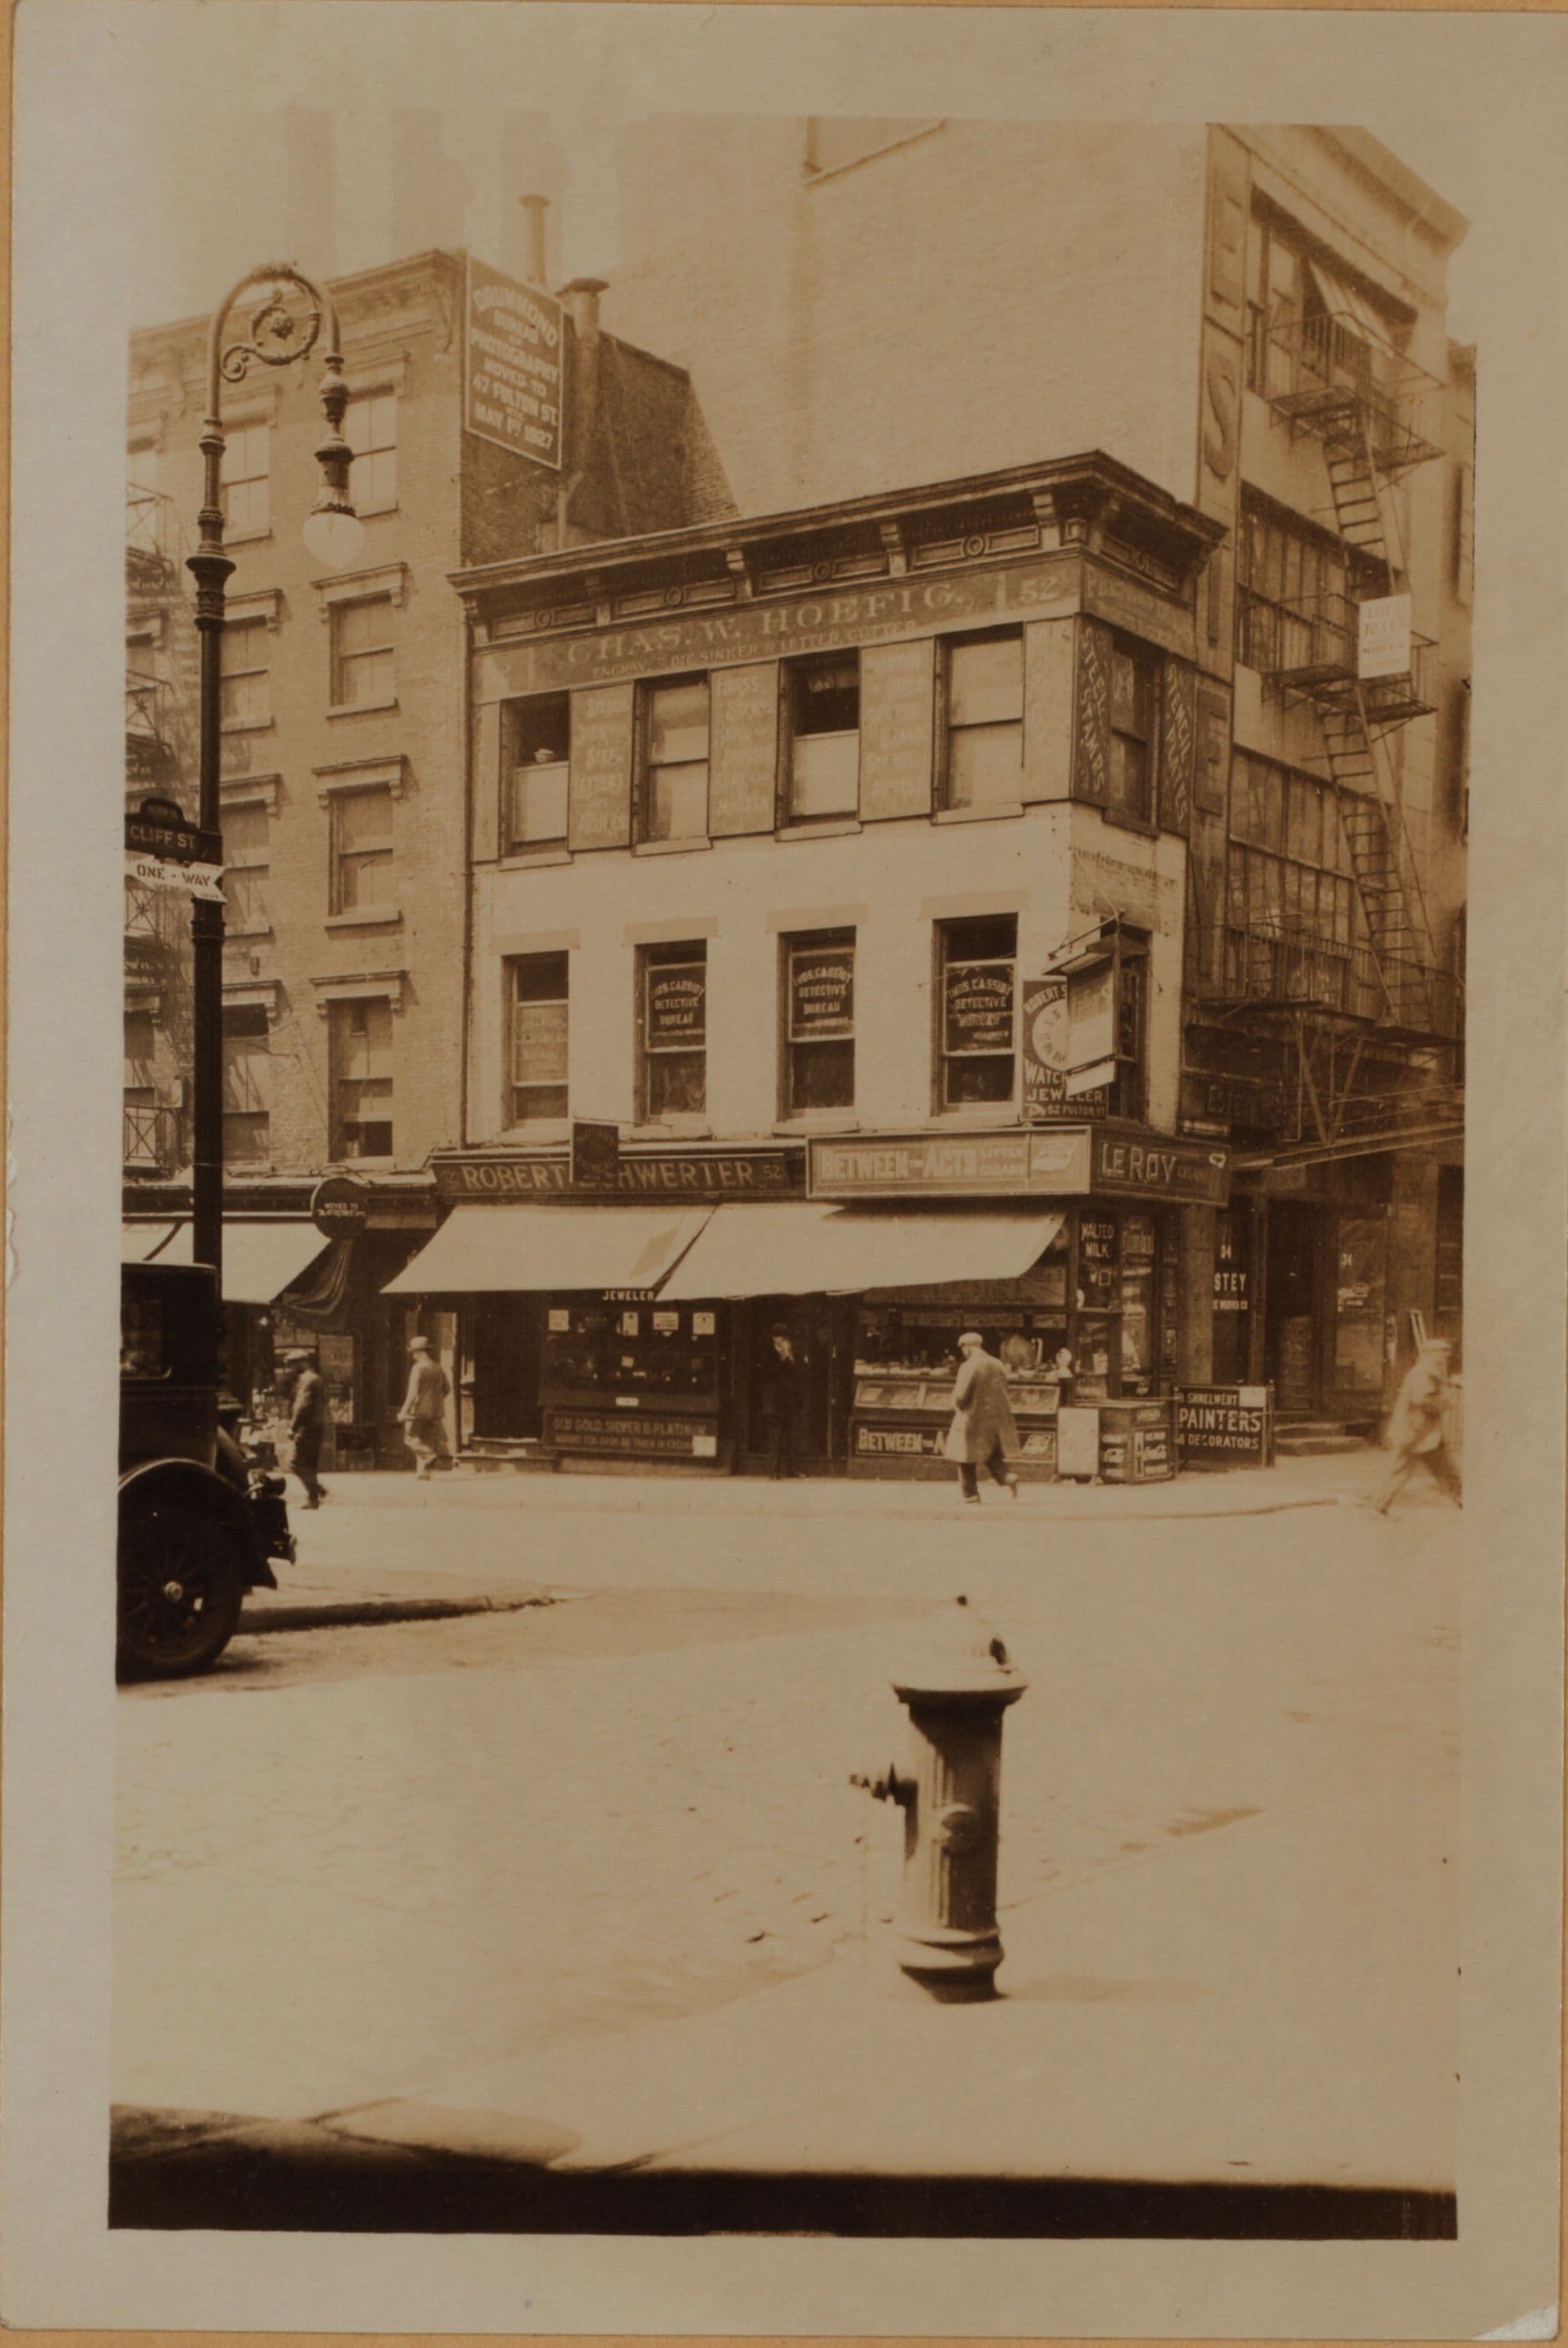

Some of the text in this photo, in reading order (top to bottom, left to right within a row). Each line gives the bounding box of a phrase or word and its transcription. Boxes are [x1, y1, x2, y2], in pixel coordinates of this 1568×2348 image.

[524, 424, 554, 450] 1927
[701, 617, 755, 641] W.
[1079, 687, 1106, 793] STAMPS
[130, 825, 197, 849] CLIFF ST
[136, 863, 166, 880] ONE
[181, 871, 210, 887] WAY
[798, 983, 846, 999] DETECTIVE
[1023, 984, 1060, 1014] ROBERT
[654, 996, 699, 1010] DETECTIVE
[803, 1000, 841, 1014] BUREAU
[953, 995, 1007, 1010] DETECTIVE
[658, 1011, 694, 1025] BUREAU
[959, 1014, 1002, 1027] BUREAU
[460, 1164, 565, 1190] ROBERT
[1085, 1241, 1111, 1258] MILK
[602, 1290, 655, 1301] JEWELER
[552, 1417, 572, 1430] OLD
[1179, 1408, 1261, 1433] PAINTERS
[1188, 1433, 1259, 1451] DECORATORS
